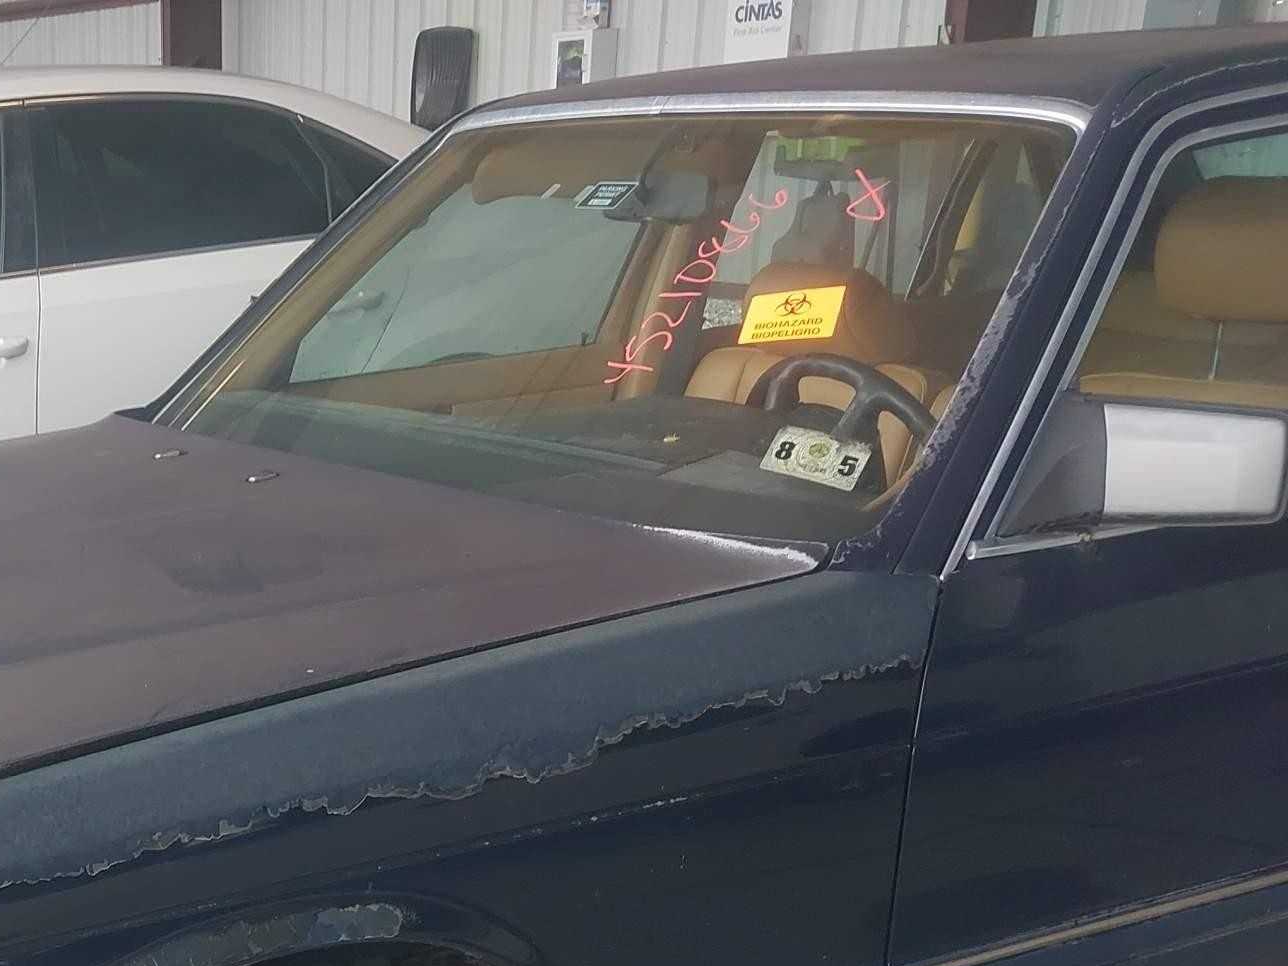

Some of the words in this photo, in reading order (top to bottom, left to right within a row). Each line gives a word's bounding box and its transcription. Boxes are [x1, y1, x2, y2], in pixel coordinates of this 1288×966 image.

[754, 317, 824, 330] BIOHAZARD
[751, 327, 821, 340] BIOPELIGRO
[775, 441, 796, 460] 8
[838, 455, 859, 476] 5
